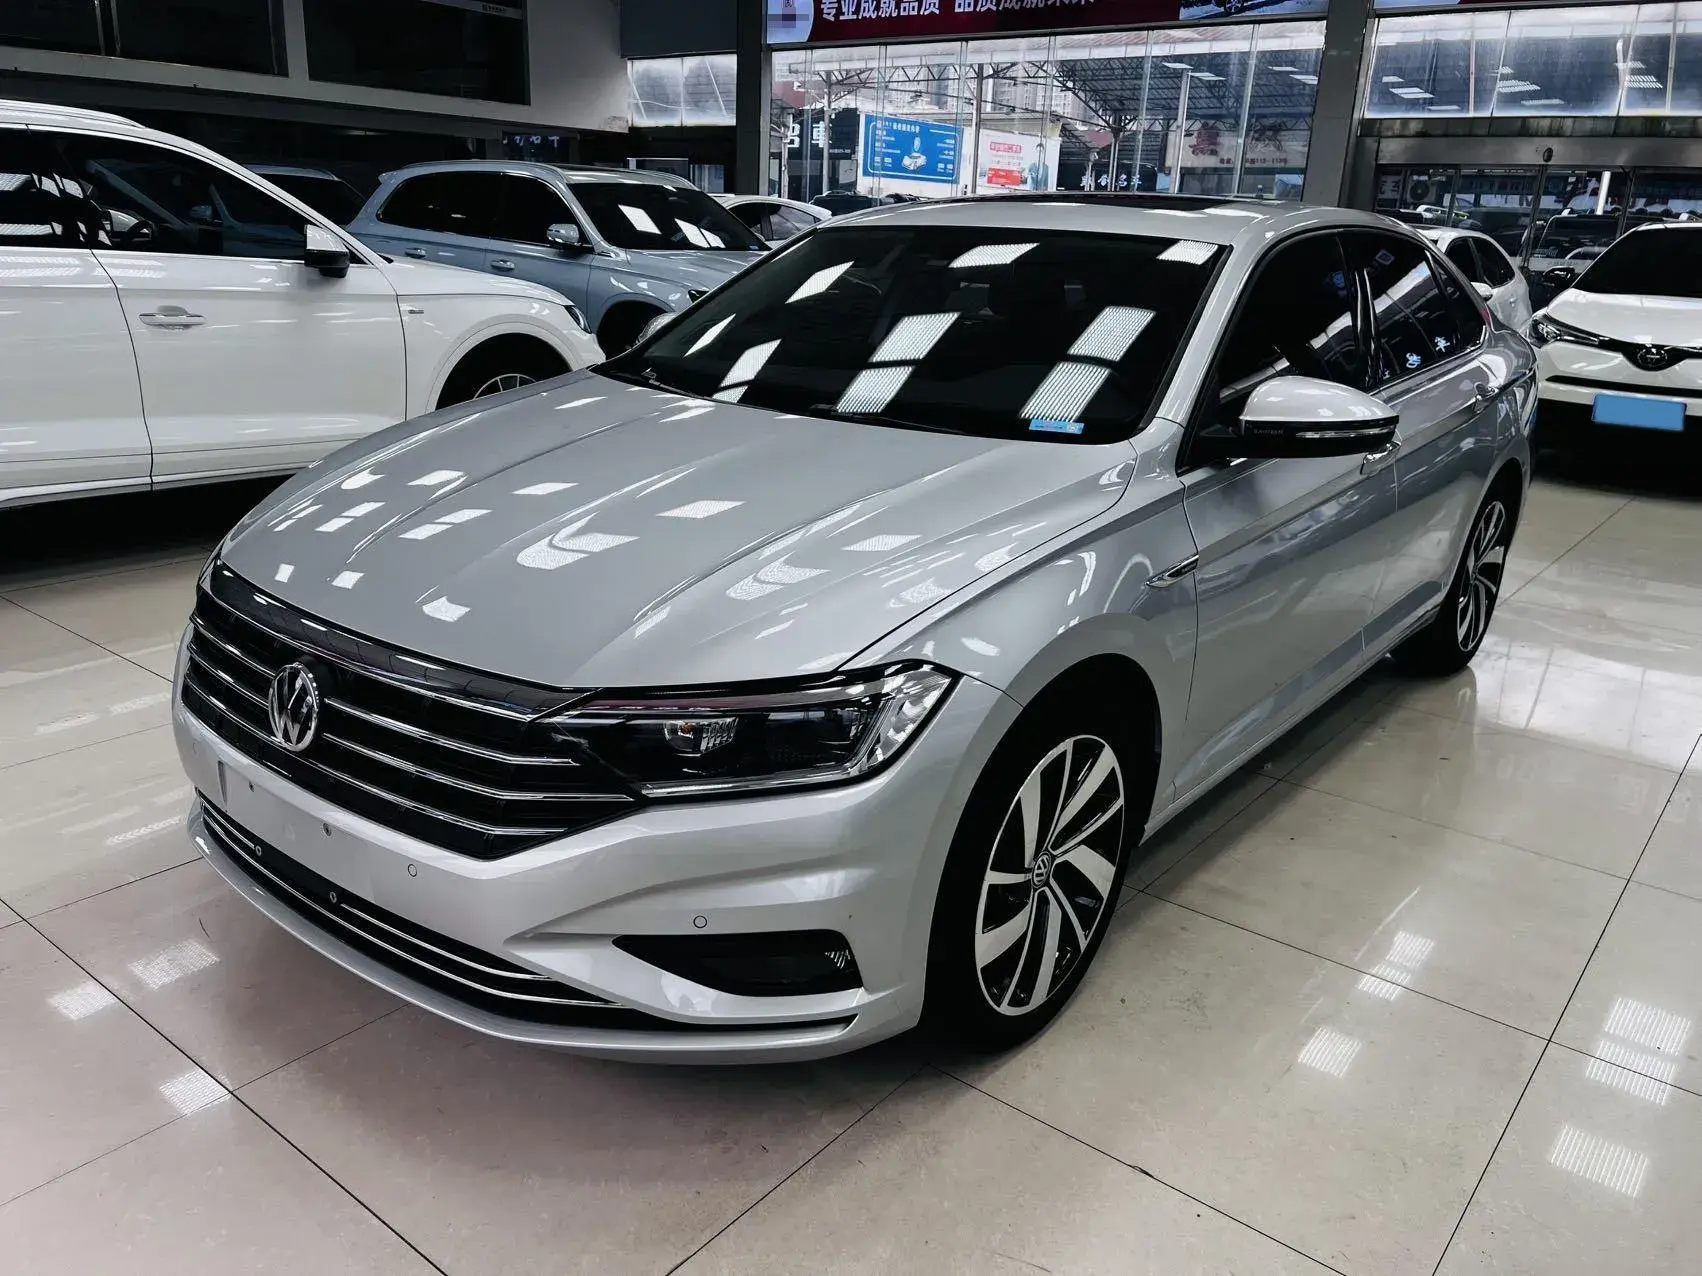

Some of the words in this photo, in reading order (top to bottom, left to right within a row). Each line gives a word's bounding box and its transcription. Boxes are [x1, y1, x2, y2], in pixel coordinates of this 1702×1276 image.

[820, 0, 940, 22] 专业成就品质
